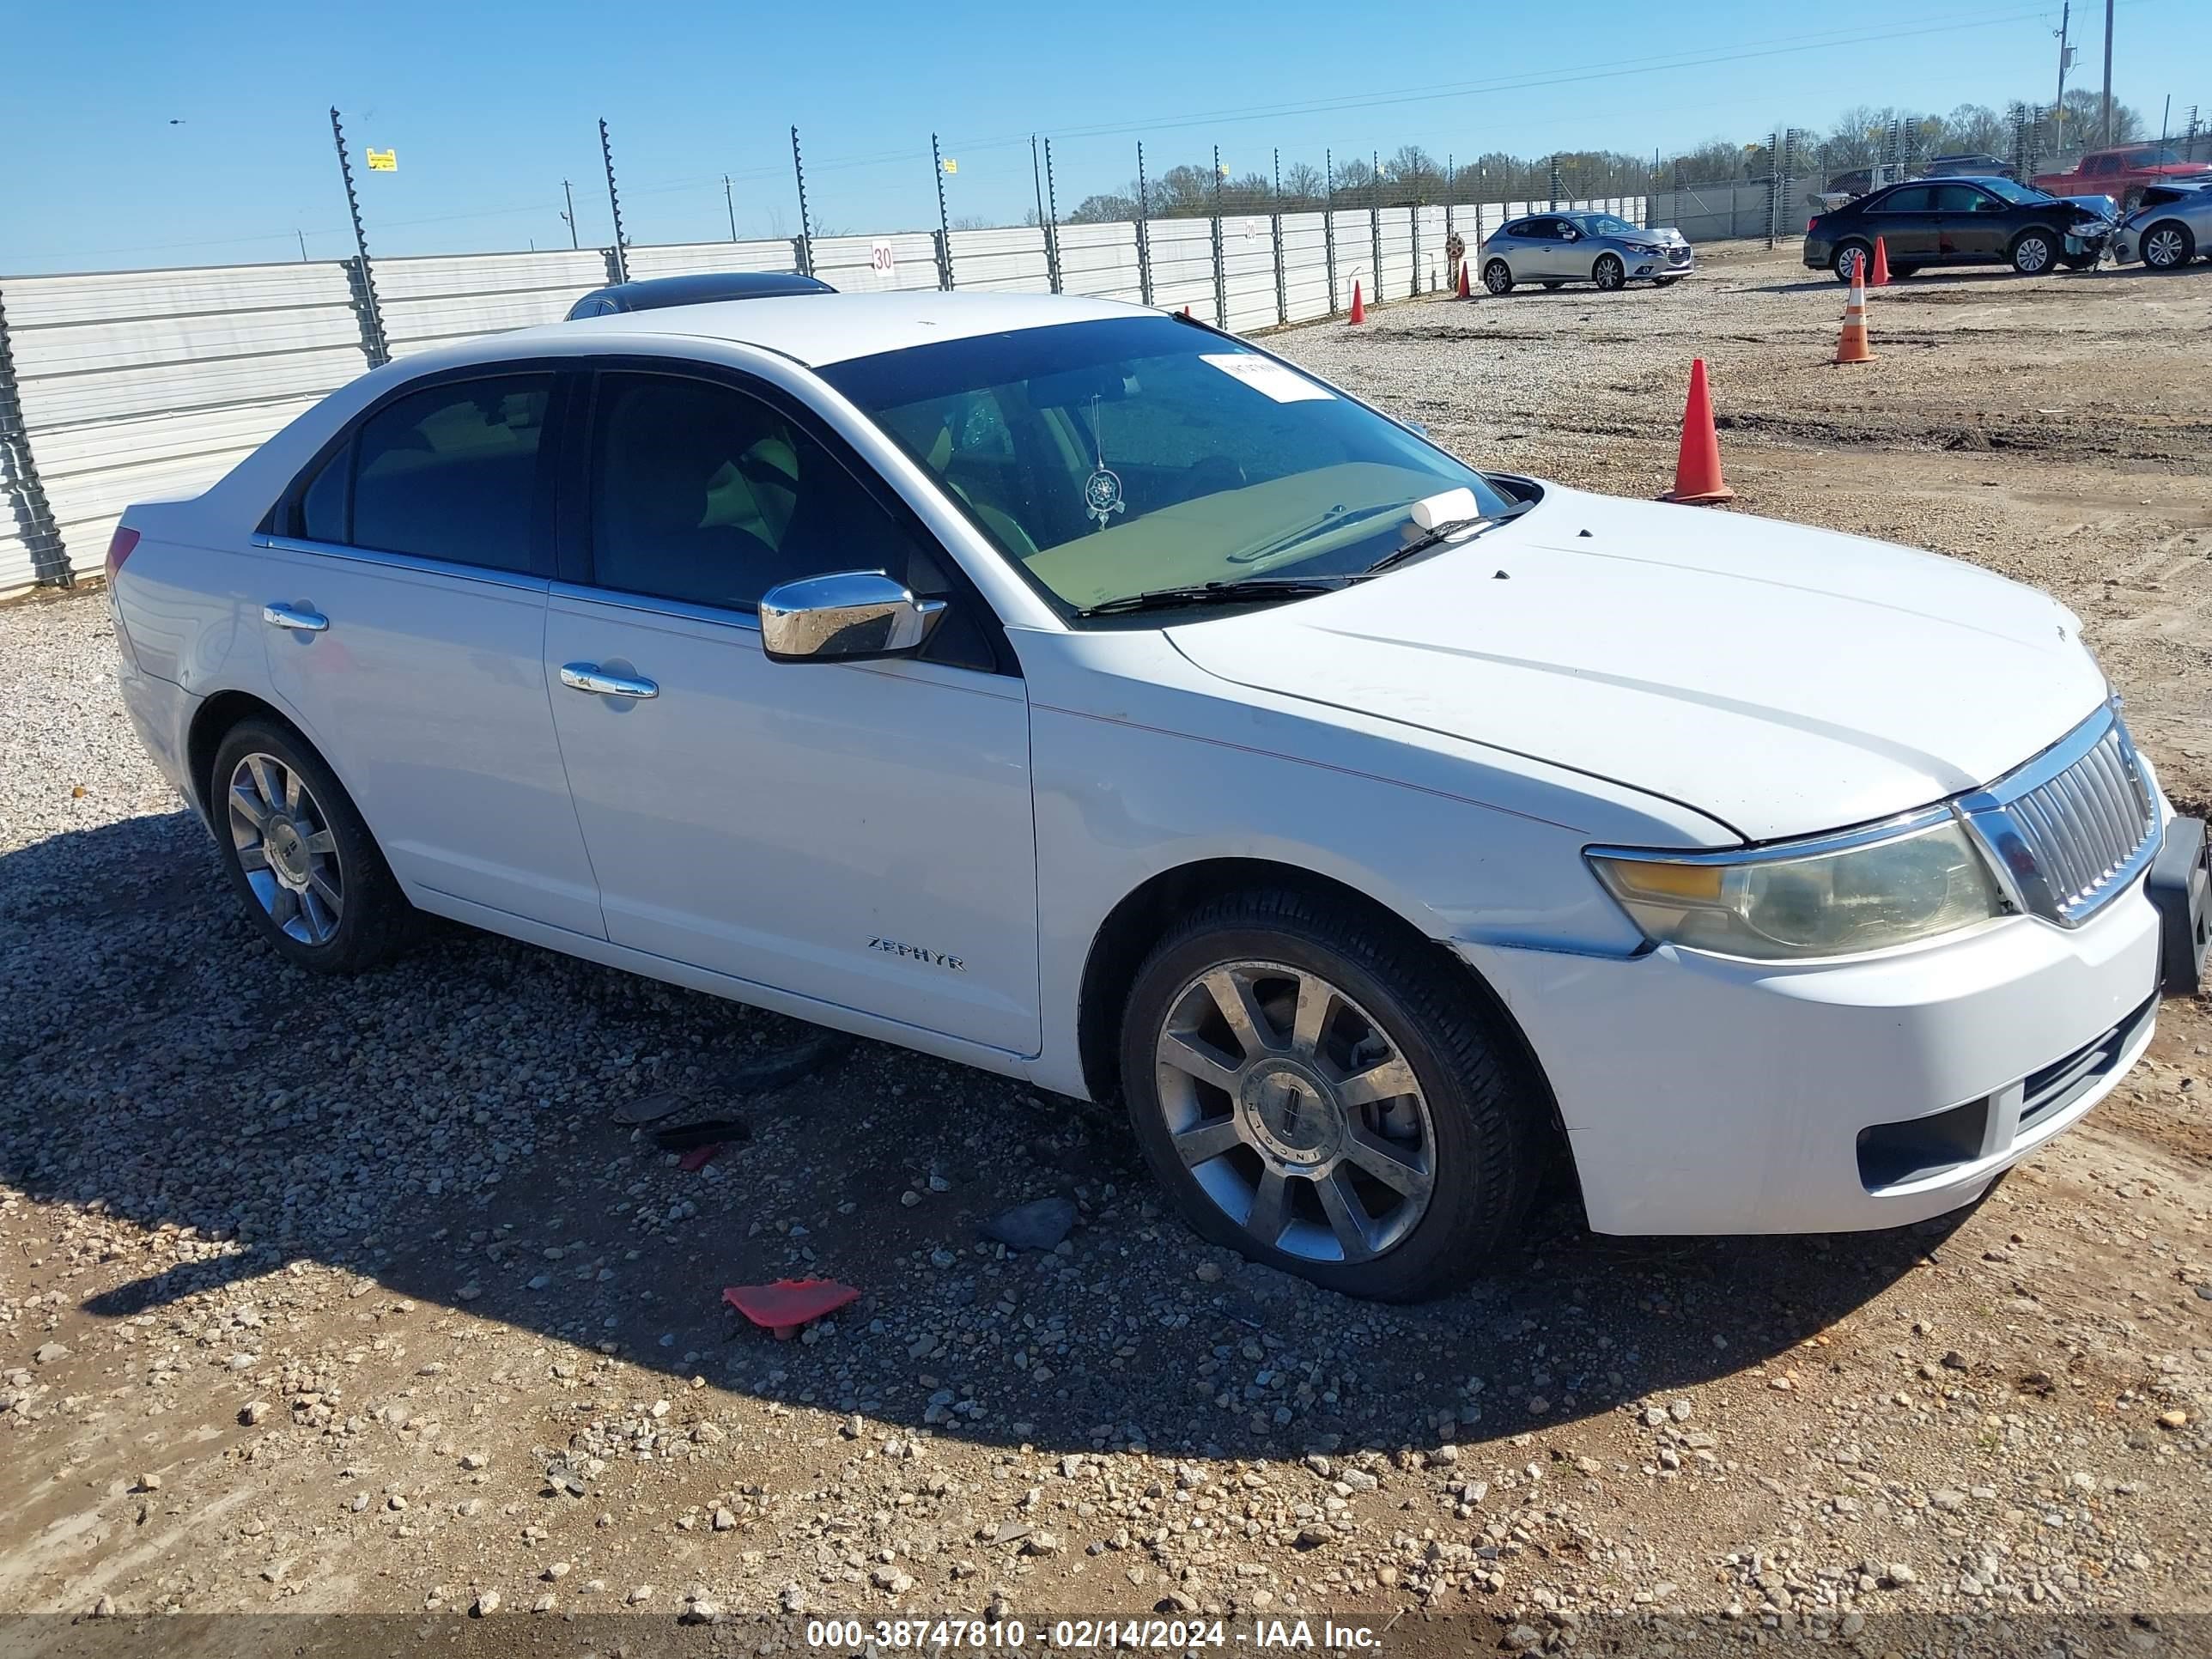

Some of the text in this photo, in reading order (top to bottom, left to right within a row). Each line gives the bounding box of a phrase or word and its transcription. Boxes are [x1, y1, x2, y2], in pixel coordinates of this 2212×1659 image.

[1247, 225, 1255, 239] 20
[874, 247, 890, 270] 30
[866, 935, 967, 972] ZEPHYR
